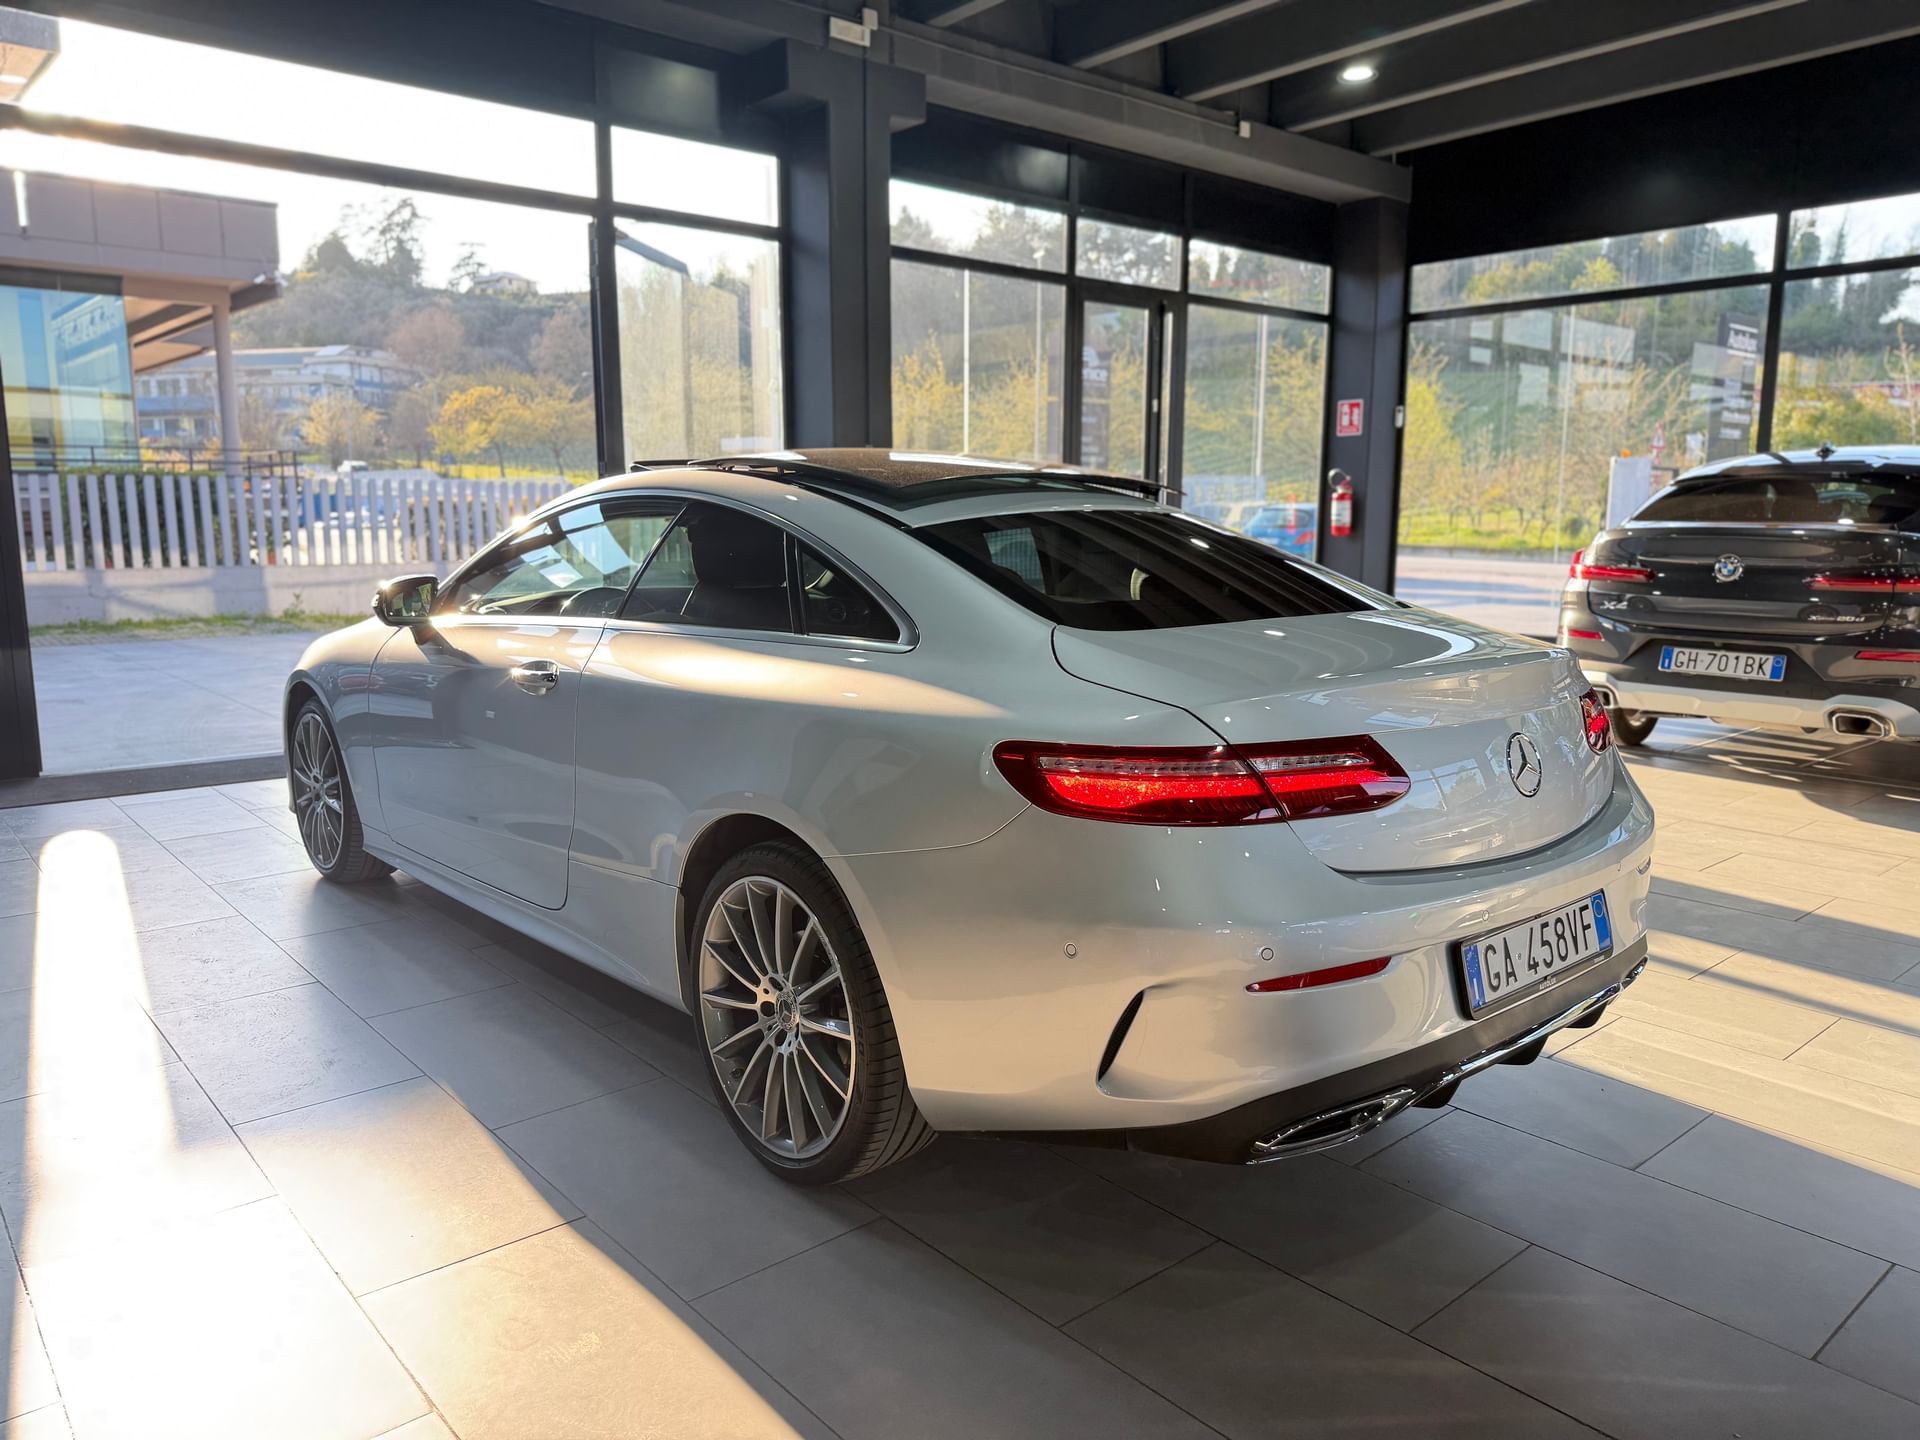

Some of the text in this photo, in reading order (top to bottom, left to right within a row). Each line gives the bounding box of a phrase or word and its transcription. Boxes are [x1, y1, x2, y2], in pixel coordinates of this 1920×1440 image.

[1674, 650, 1770, 676] GH 701BK
[1484, 904, 1592, 992] GA 458VF
